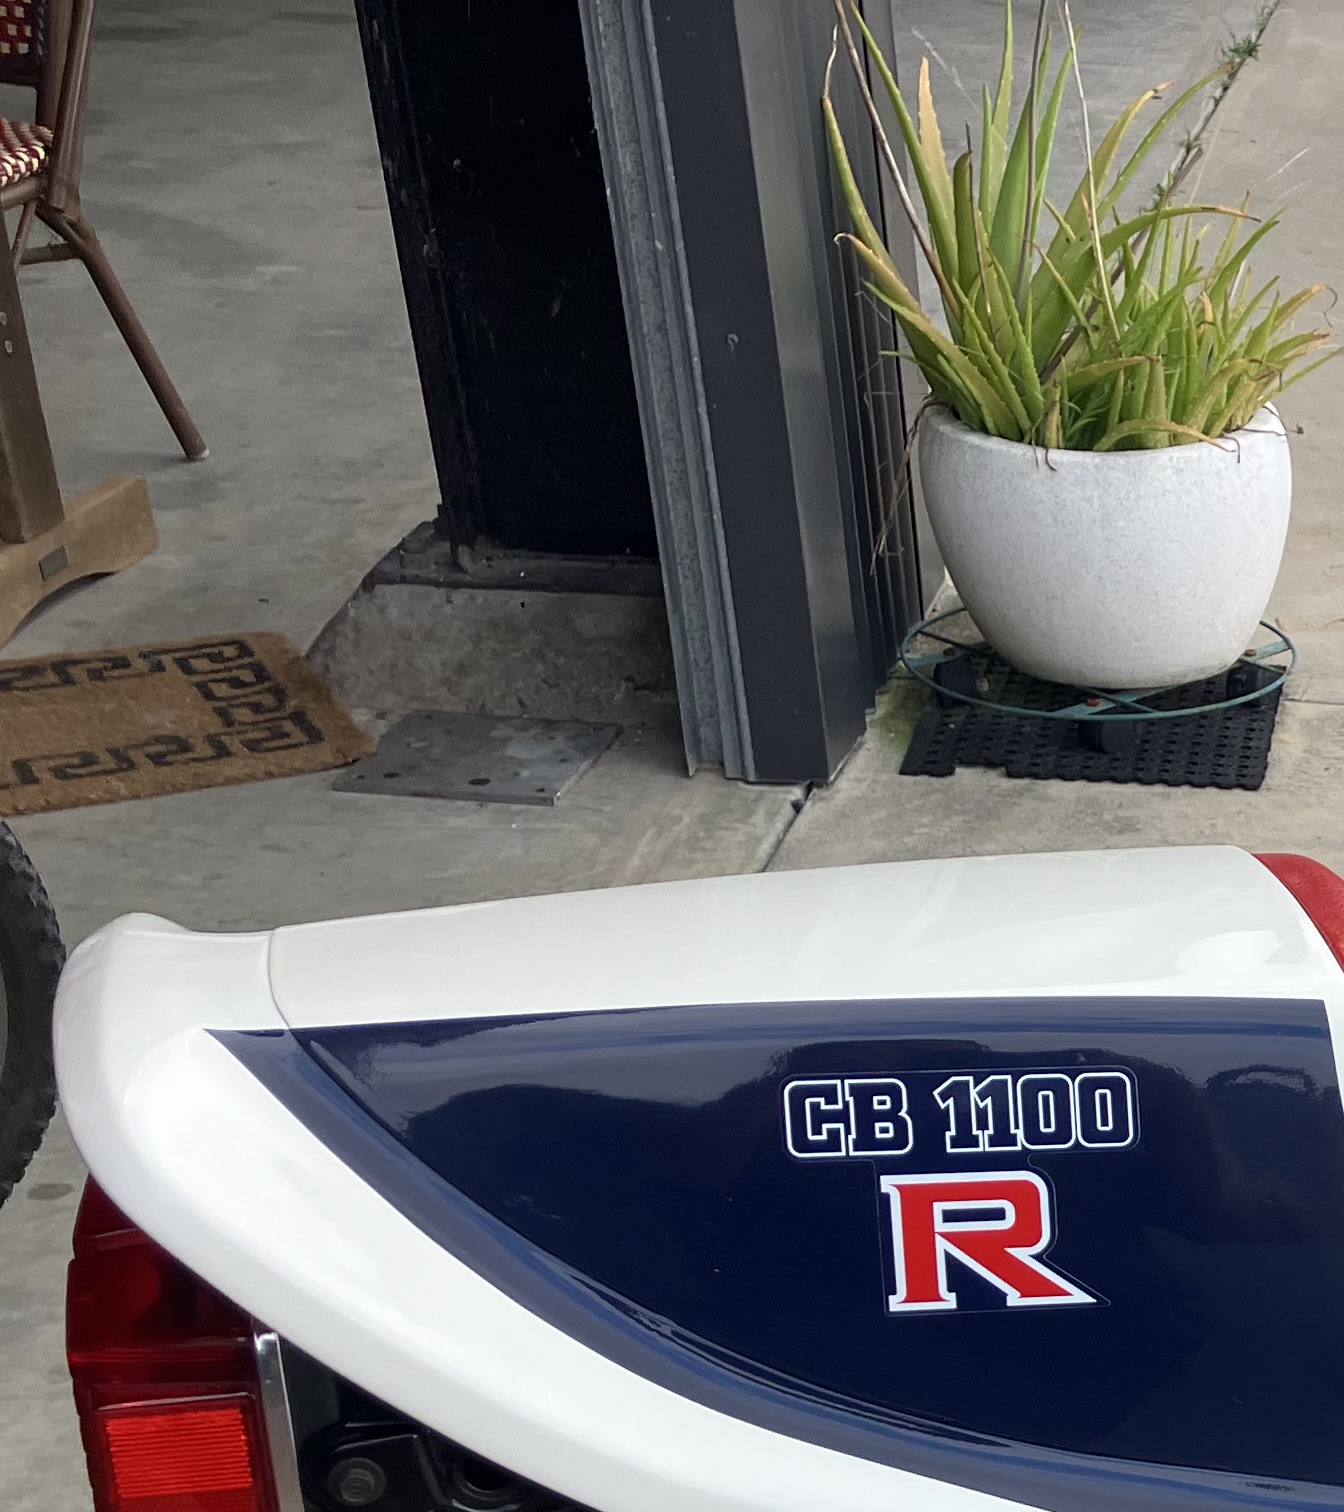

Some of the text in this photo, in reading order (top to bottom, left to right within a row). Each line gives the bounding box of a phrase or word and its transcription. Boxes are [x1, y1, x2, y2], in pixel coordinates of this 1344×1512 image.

[783, 1071, 1135, 1158] CB 1100
[879, 1169, 1098, 1313] R
